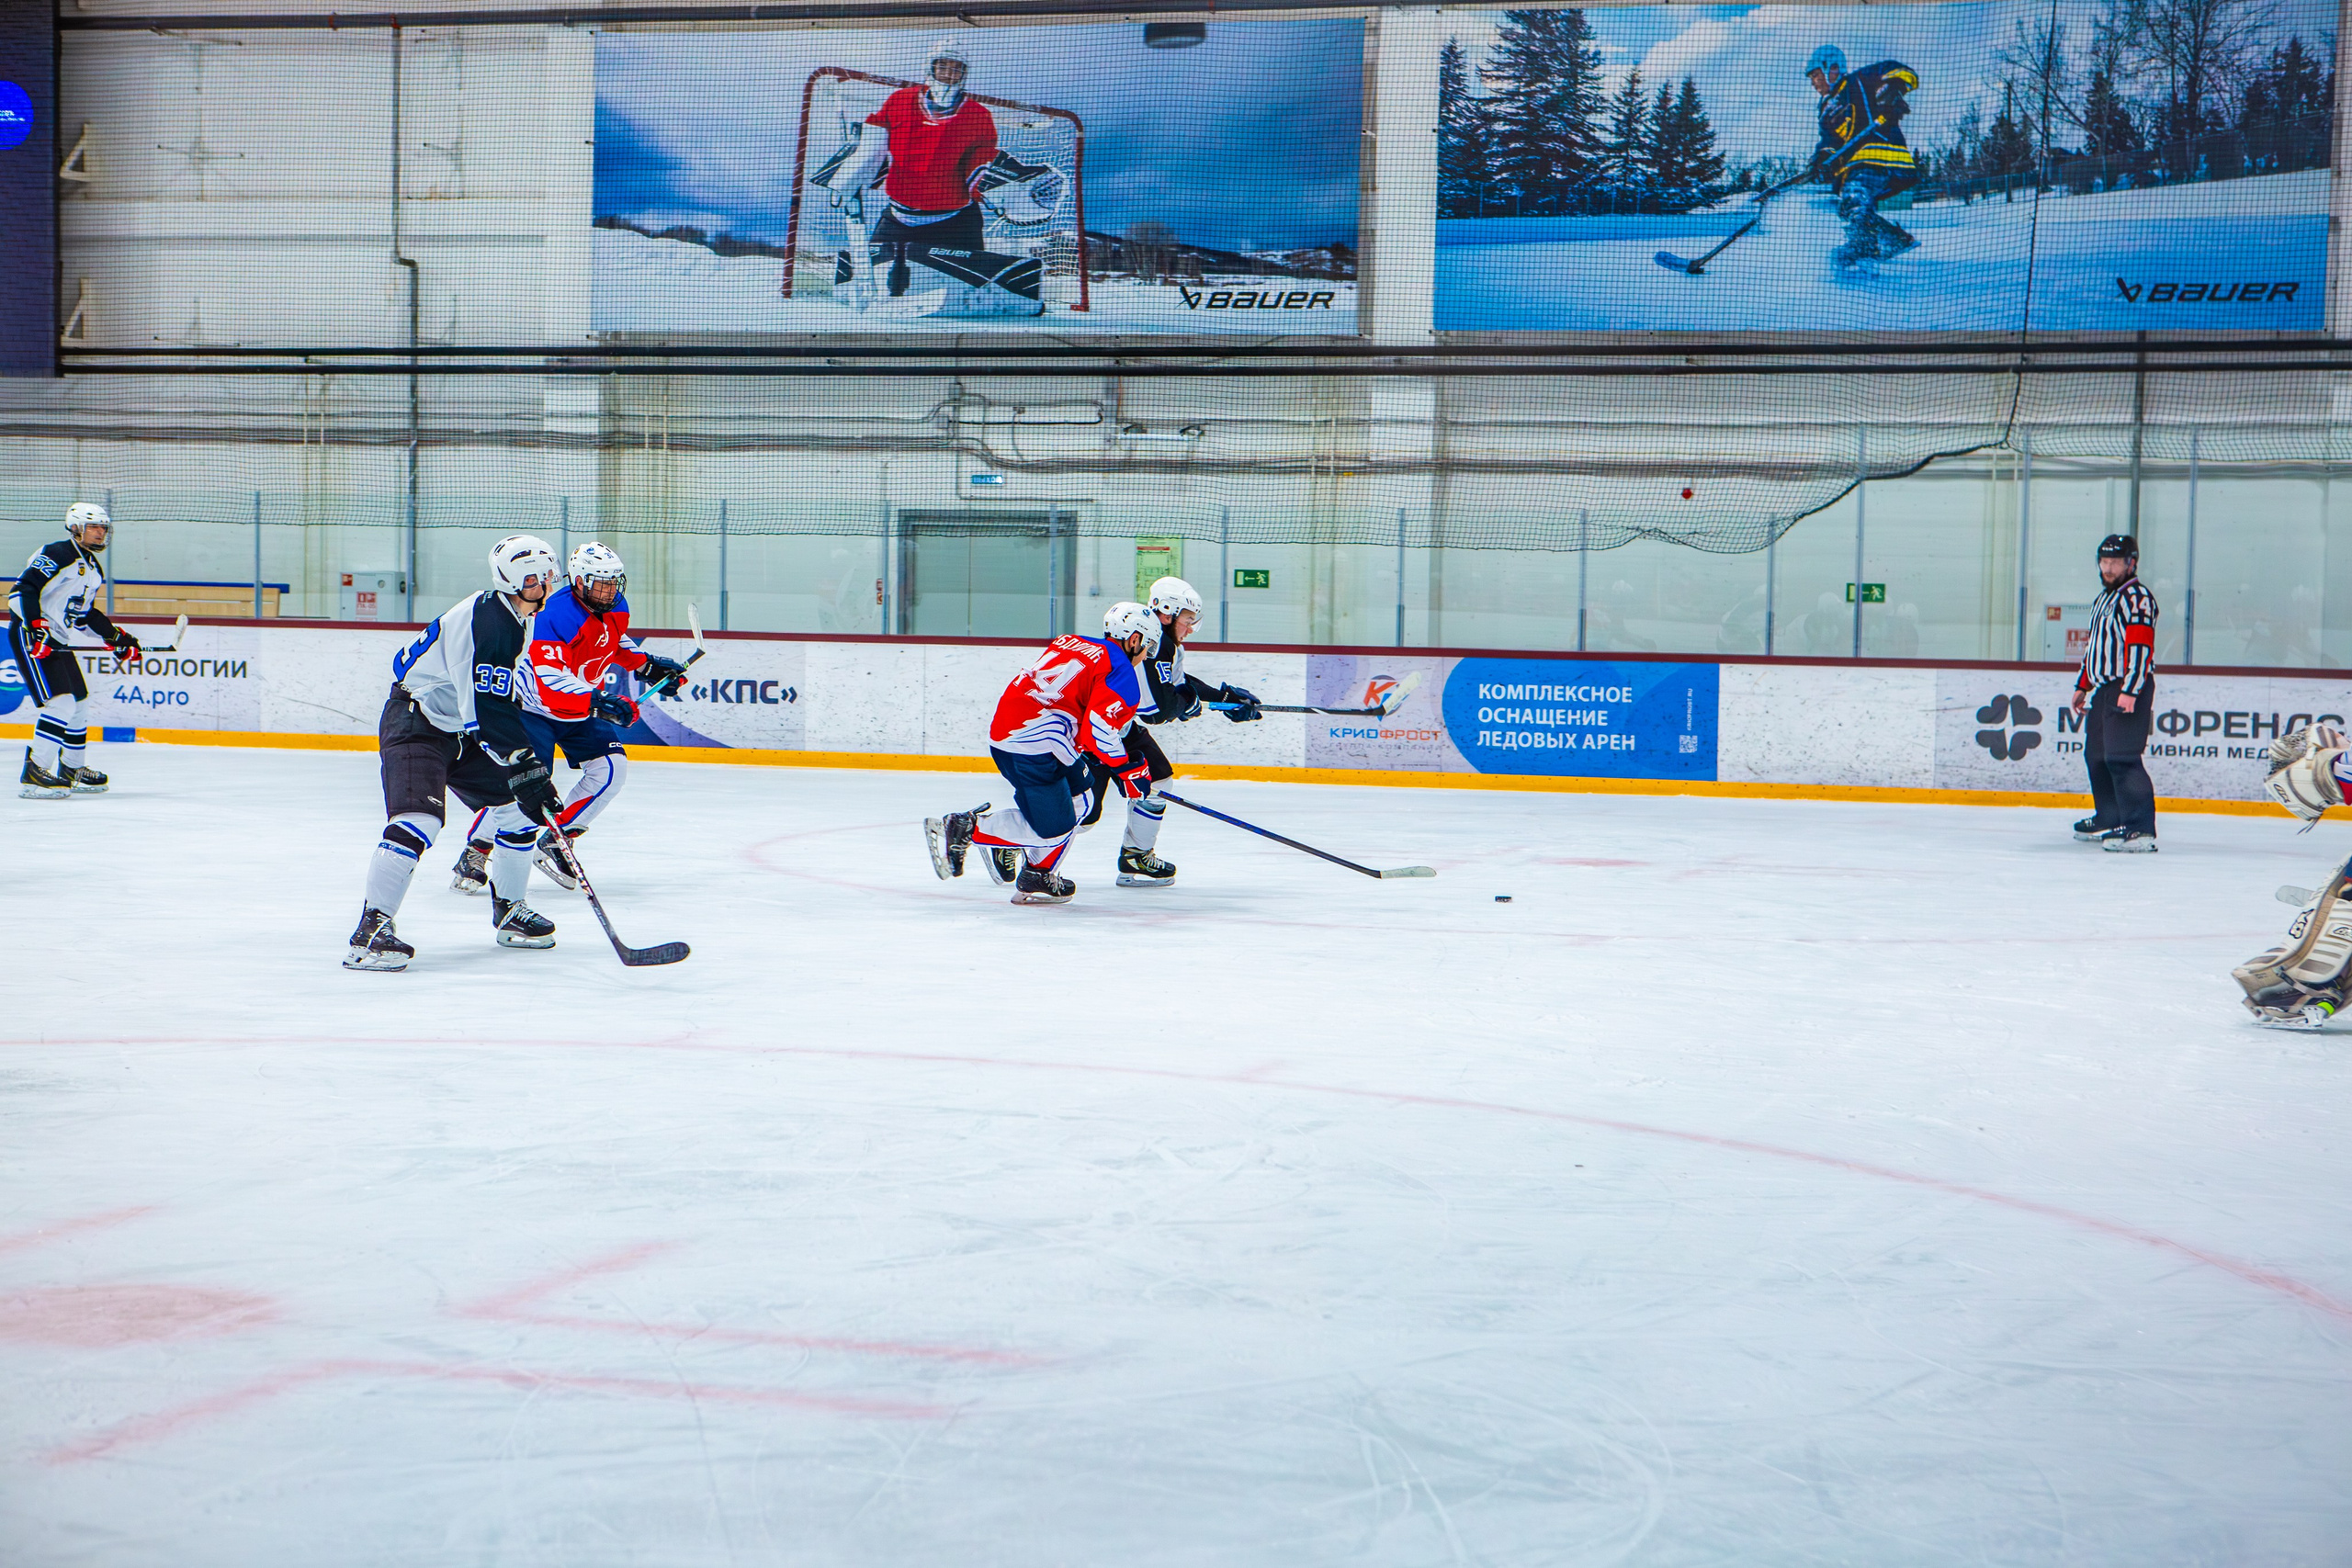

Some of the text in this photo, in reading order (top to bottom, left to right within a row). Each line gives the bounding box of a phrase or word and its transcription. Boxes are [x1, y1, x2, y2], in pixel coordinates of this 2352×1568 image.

[1205, 291, 1335, 310] BAUER
[2147, 282, 2300, 302] BAUER
[31, 554, 59, 579] 52
[2130, 594, 2152, 615] 14
[83, 656, 248, 678] ТЕХНОЛОГИИ
[473, 663, 513, 696] 33
[691, 679, 798, 705] «КПС»
[1479, 682, 1633, 704] КОМПЛЕКСНОЕ
[1478, 706, 1609, 728] ОСНАЩЕНИЕ
[1329, 728, 1442, 741] КРИОФРОСТ
[1476, 730, 1636, 751] ЛЕДОВЫХ АРЕН
